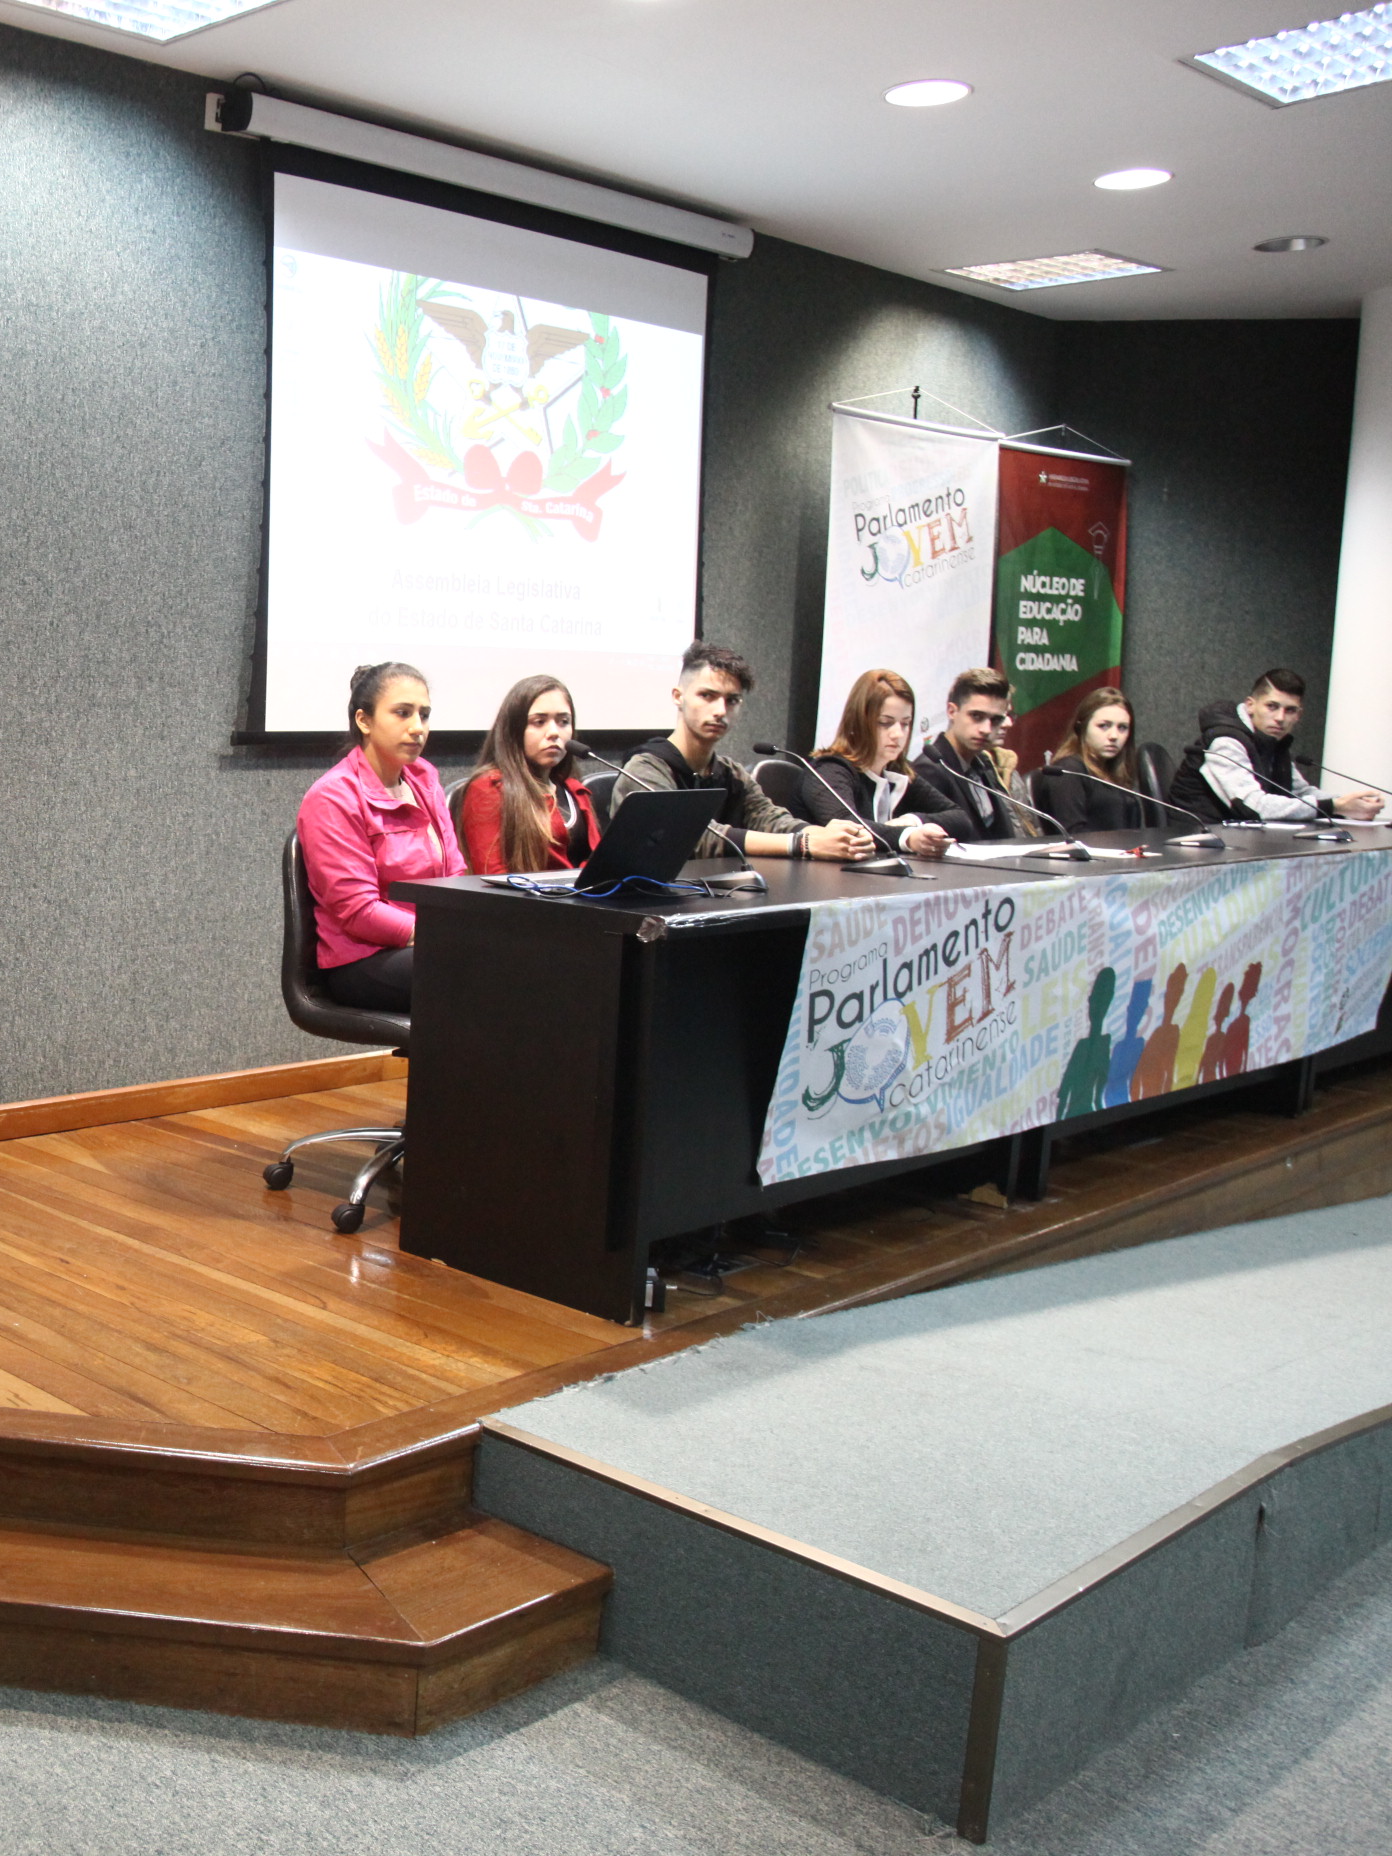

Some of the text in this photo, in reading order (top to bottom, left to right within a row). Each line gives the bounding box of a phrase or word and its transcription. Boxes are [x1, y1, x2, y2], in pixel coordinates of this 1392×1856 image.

[413, 484, 458, 505] Estado
[461, 492, 477, 507] de
[544, 501, 594, 523] Catarina
[854, 487, 965, 542] Parlamento
[392, 568, 581, 601] Assembleia Legislativa
[1020, 569, 1085, 596] NÚCLEO DE
[368, 604, 602, 637] do Estado de Santa Catarina
[1017, 626, 1049, 645] PARA
[1019, 598, 1082, 626] EDUCAÇÃO
[1015, 652, 1079, 671] CIDADANIA
[1300, 850, 1389, 933] CULTURA
[1348, 868, 1392, 930] DEBAT
[1020, 884, 1088, 951] DEBATE
[808, 896, 1015, 1043] Parlamento
[809, 942, 888, 990] Programa
[802, 931, 1015, 1114] JOVEM
[1021, 958, 1089, 1040] LEIS
[946, 1023, 1059, 1135] IGUALDADE
